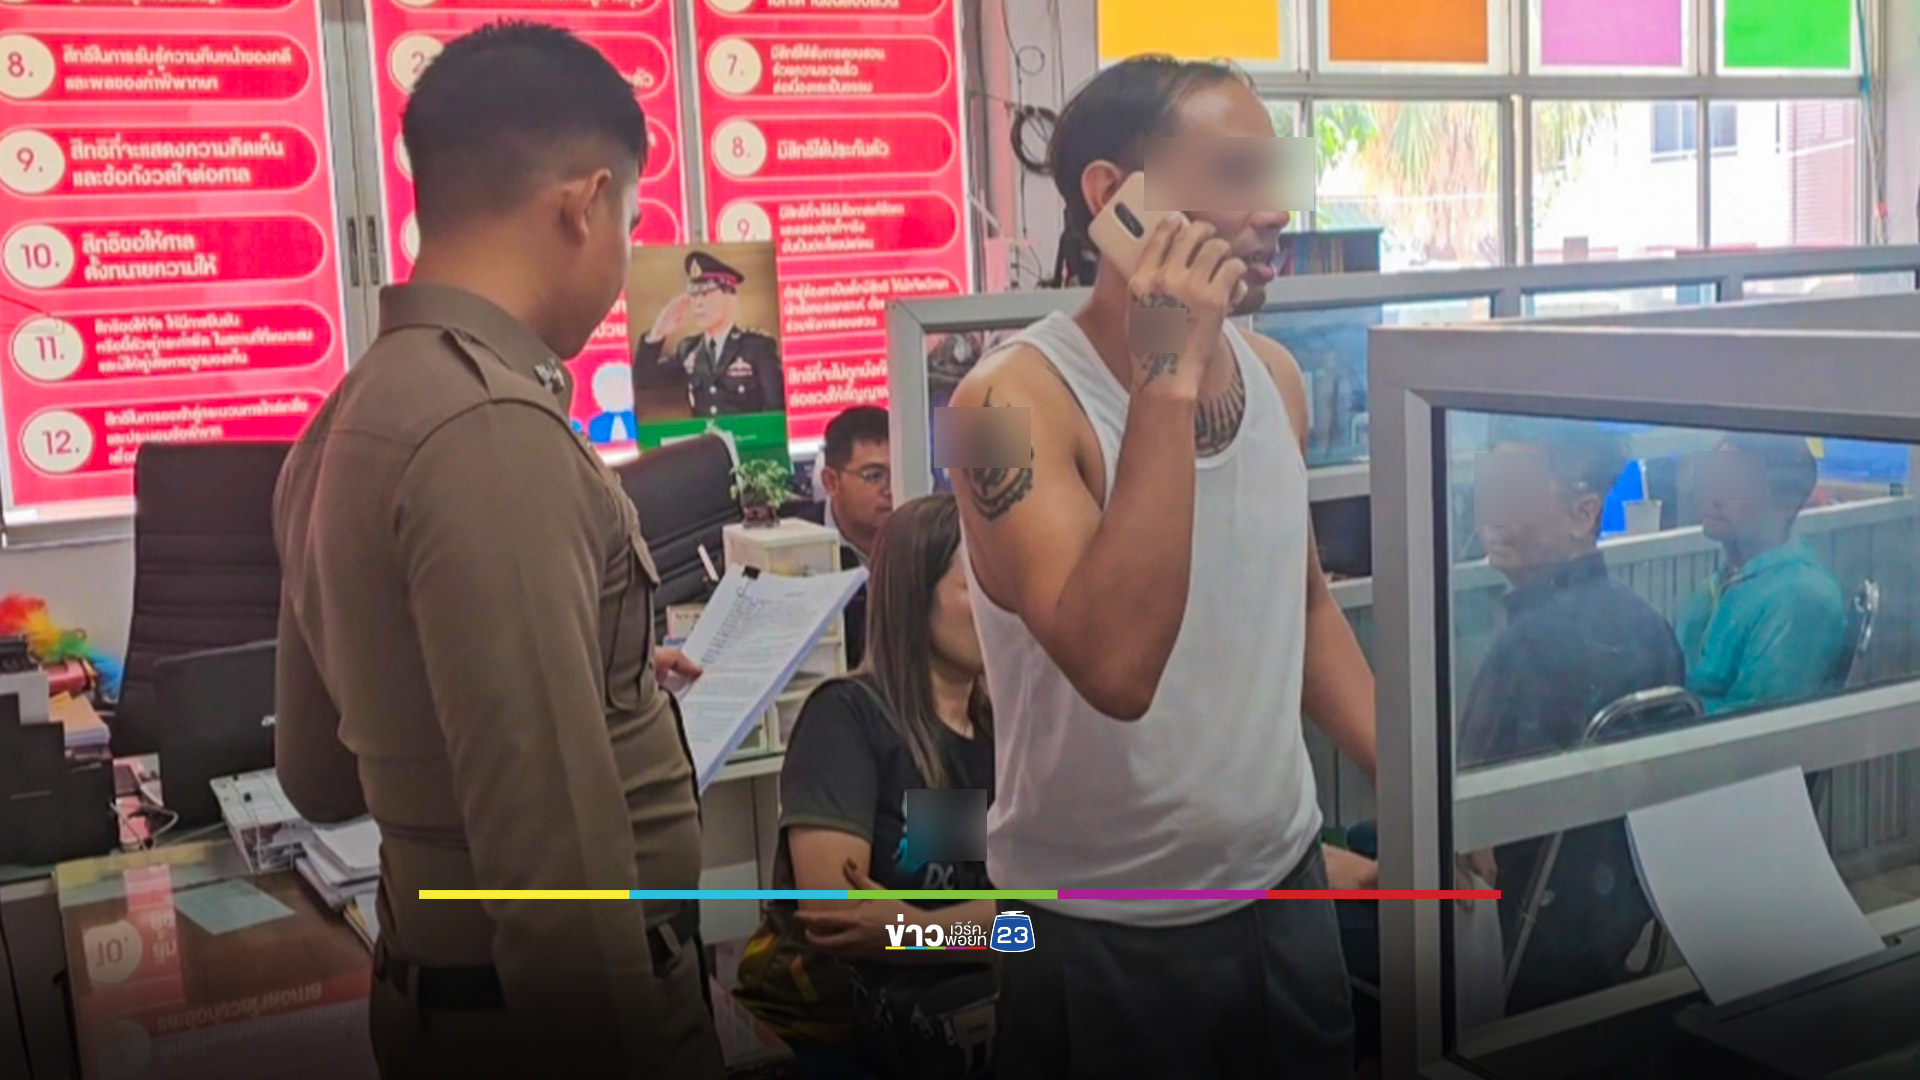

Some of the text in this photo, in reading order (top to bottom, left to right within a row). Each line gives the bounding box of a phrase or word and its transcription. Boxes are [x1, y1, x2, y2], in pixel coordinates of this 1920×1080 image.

[7, 52, 34, 77] 8.
[727, 54, 745, 76] 7.
[70, 133, 284, 160] สิทธิที่จะแสดงความคิดเห็น
[732, 136, 752, 158] 8.
[16, 148, 43, 172] 9.
[73, 162, 251, 187] และข้อกังวลใจต่อศาล
[81, 229, 195, 255] สิทธิขอให้ศาล
[20, 243, 60, 269] 10.
[84, 252, 218, 281] ตั้งทนายความให้
[35, 336, 65, 361] 11.
[41, 429, 80, 455] 12.
